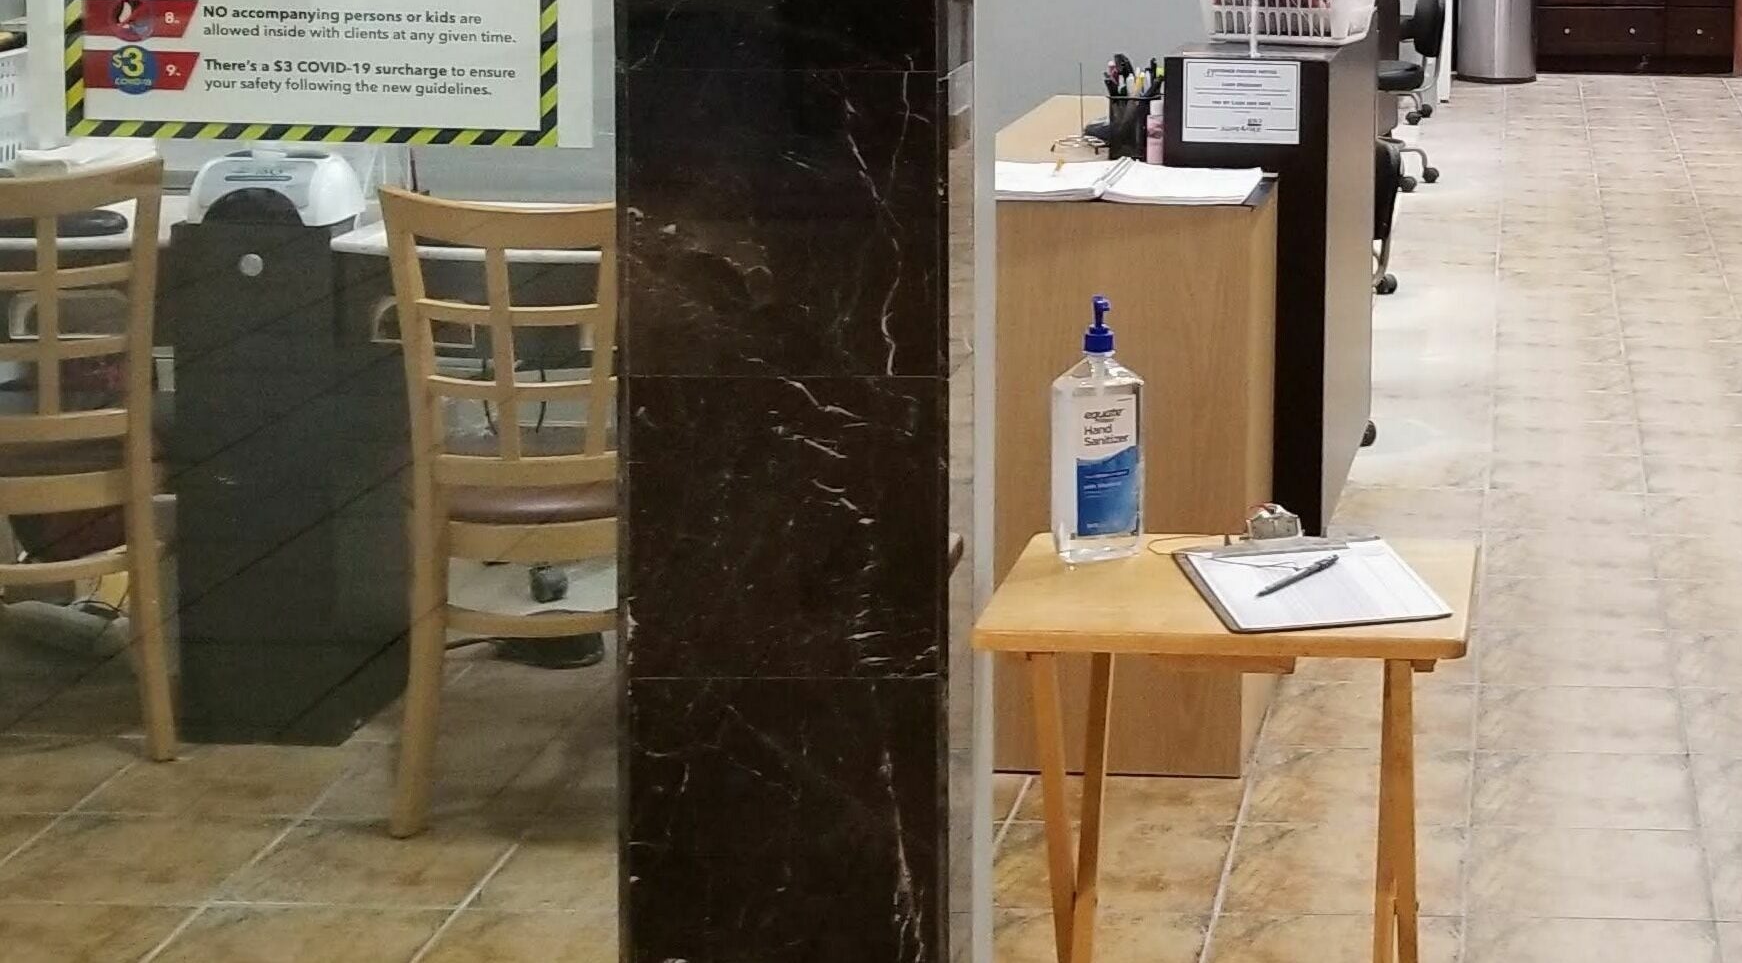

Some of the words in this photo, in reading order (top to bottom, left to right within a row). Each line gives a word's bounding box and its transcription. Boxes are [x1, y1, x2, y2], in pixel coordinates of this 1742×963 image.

[164, 12, 180, 25] 8.
[203, 5, 227, 17] NO
[231, 9, 339, 24] accompanying
[344, 12, 402, 25] persons
[406, 13, 421, 22] or
[425, 10, 456, 23] kids
[460, 15, 481, 24] are
[203, 22, 259, 36] allowed
[263, 24, 306, 37] inside
[309, 25, 340, 38] with
[344, 26, 389, 39] clients
[392, 30, 406, 41] at
[410, 33, 435, 45] any
[438, 32, 479, 45] given
[481, 30, 516, 42] time.
[165, 65, 181, 78] 9.
[203, 58, 257, 71] There's
[261, 62, 269, 71] a
[297, 60, 370, 74] COVID-19
[375, 62, 447, 79] surcharge
[451, 66, 465, 76] to
[469, 68, 515, 78] ensure
[204, 79, 237, 91] your
[240, 76, 283, 93] safety
[284, 76, 351, 95] following
[354, 79, 378, 92] the
[382, 84, 411, 92] new
[415, 81, 492, 98] guidelines.
[1084, 424, 1112, 435] Hand
